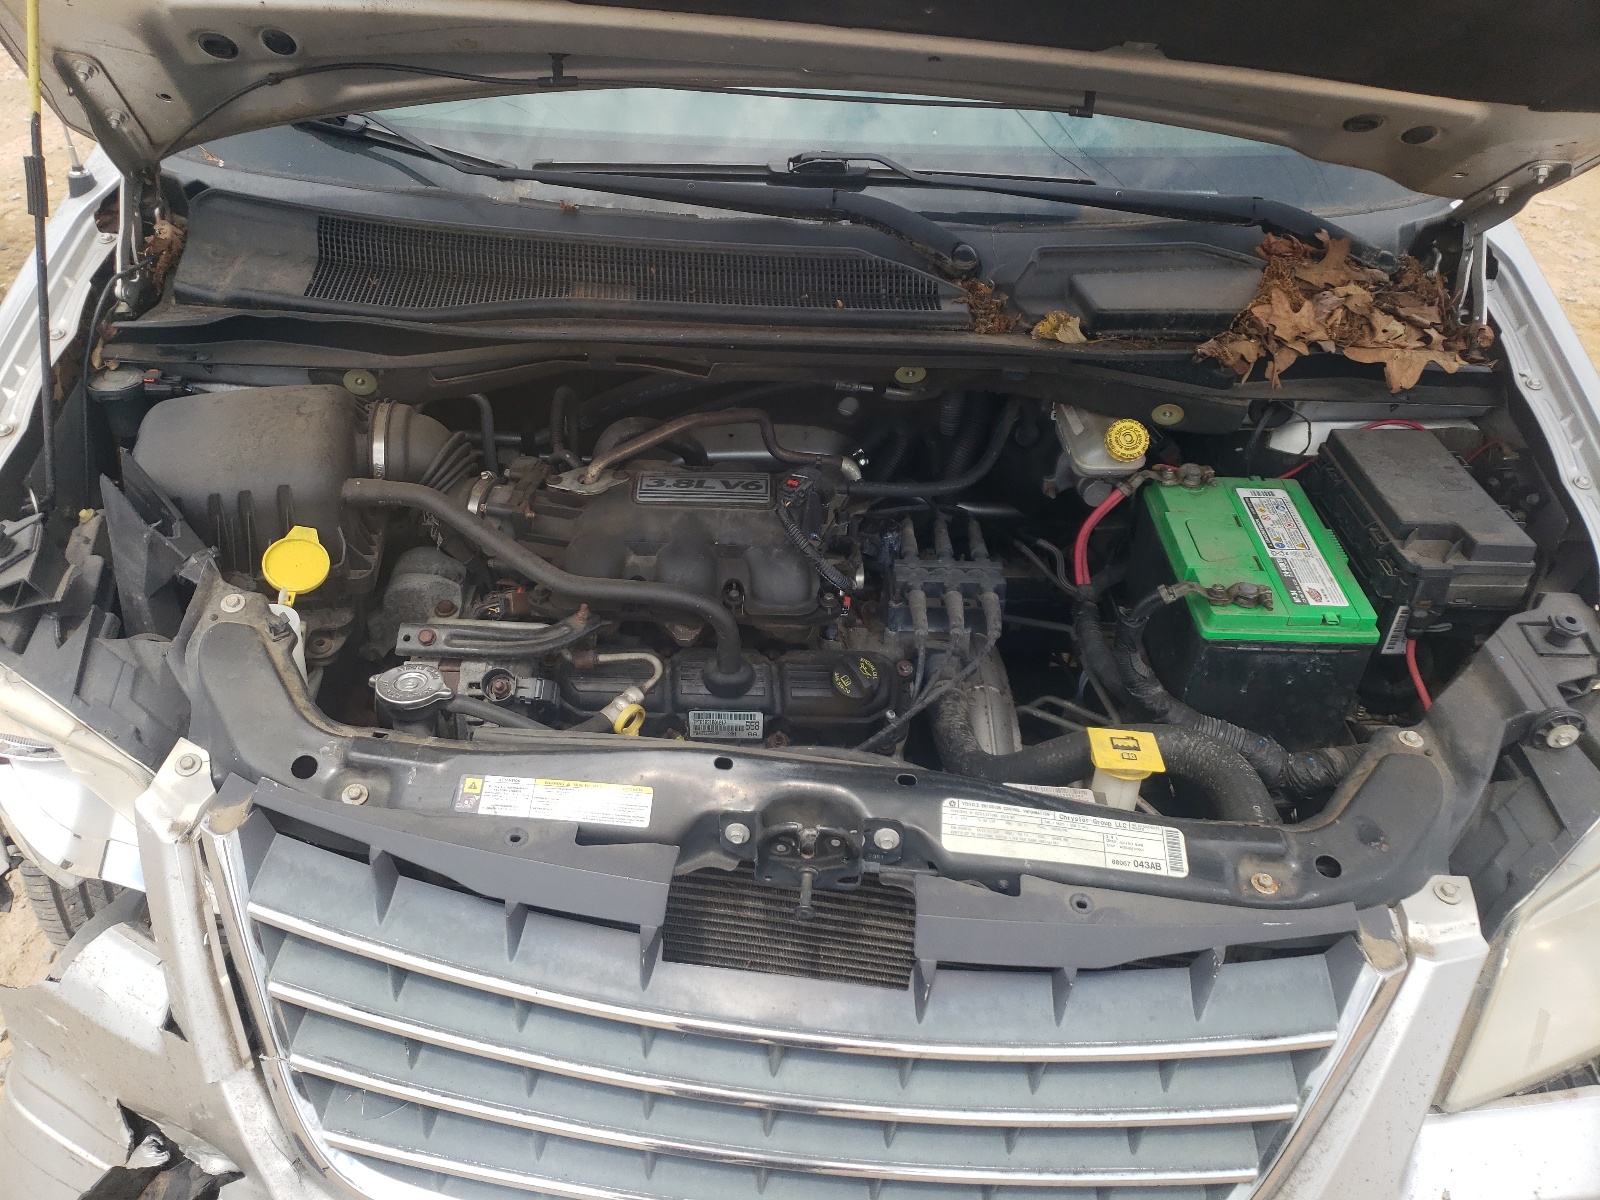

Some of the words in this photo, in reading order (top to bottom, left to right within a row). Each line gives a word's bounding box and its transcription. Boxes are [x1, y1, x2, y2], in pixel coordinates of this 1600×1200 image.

[645, 477, 716, 490] 3.8L
[720, 479, 764, 491] V6
[1059, 814, 1089, 824] Chrysler
[1093, 818, 1112, 828] Group
[1133, 859, 1162, 871] 043AB
